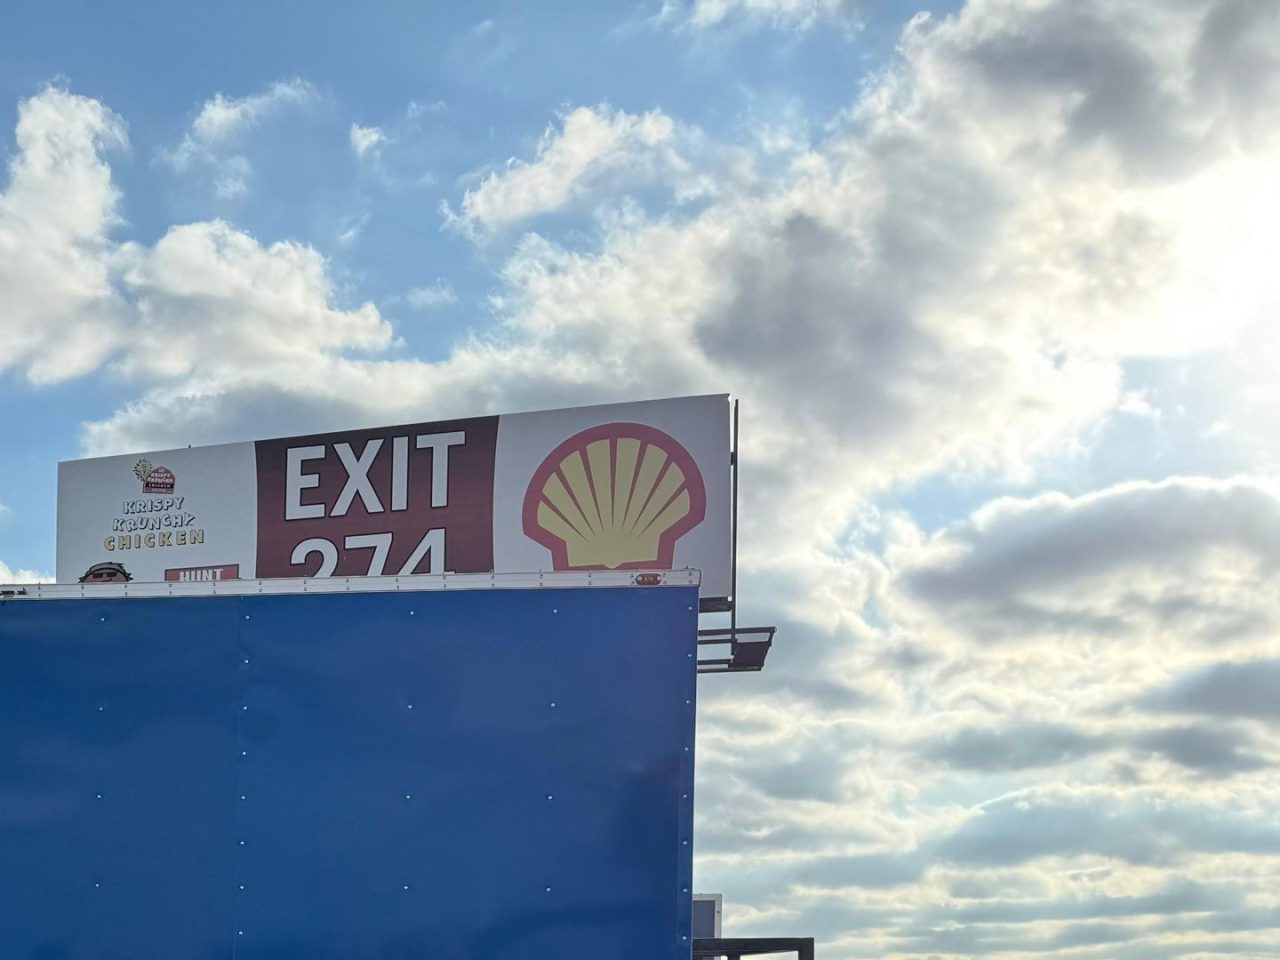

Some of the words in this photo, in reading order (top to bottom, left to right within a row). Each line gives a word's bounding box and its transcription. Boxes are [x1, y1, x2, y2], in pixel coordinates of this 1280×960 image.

[285, 430, 466, 521] EXIT
[123, 497, 184, 514] KRISPY
[112, 512, 195, 532] KRUNCHY
[104, 529, 204, 551] CHICKEN
[290, 528, 456, 577] 274
